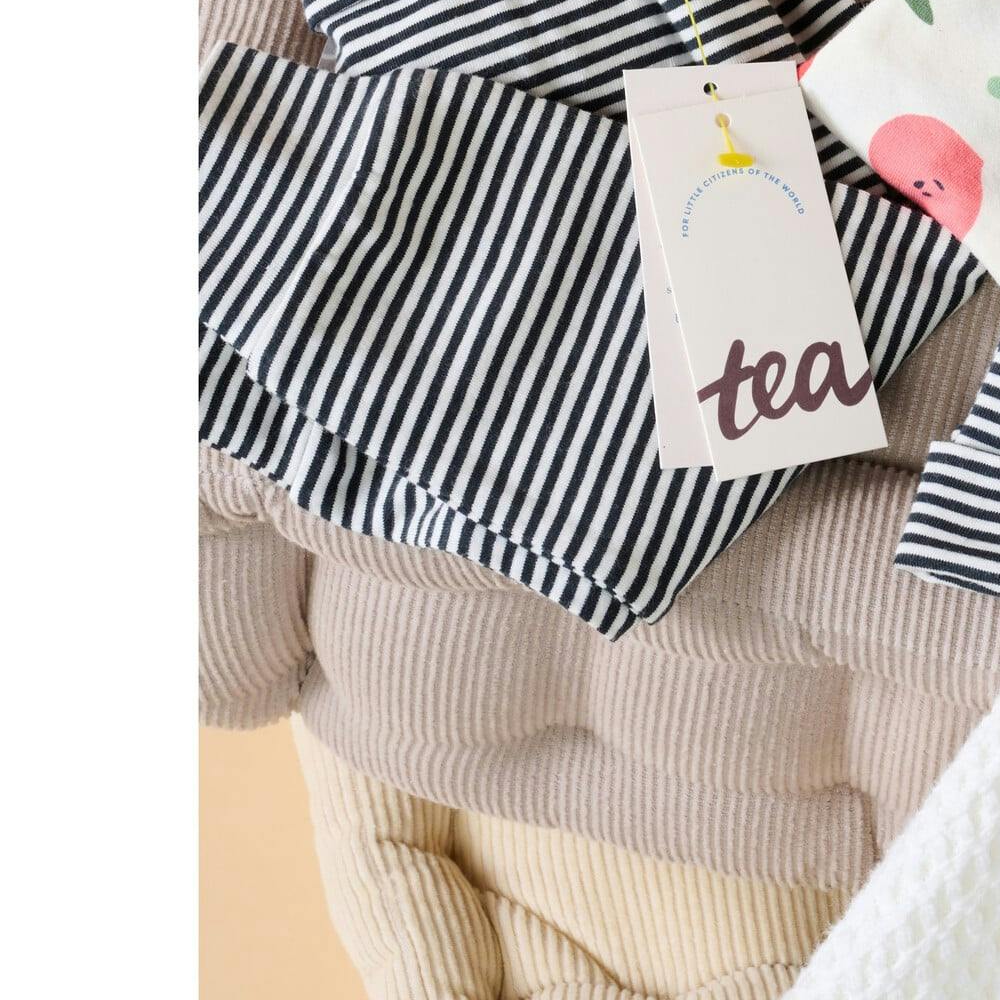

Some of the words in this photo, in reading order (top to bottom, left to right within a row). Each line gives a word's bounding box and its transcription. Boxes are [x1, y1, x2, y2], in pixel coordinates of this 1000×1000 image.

[684, 187, 703, 215] LITTLE
[703, 168, 744, 187] CITIZENS
[748, 168, 761, 176] OF
[764, 172, 781, 185] THE
[782, 184, 805, 215] WORLD
[698, 339, 874, 440] tea
